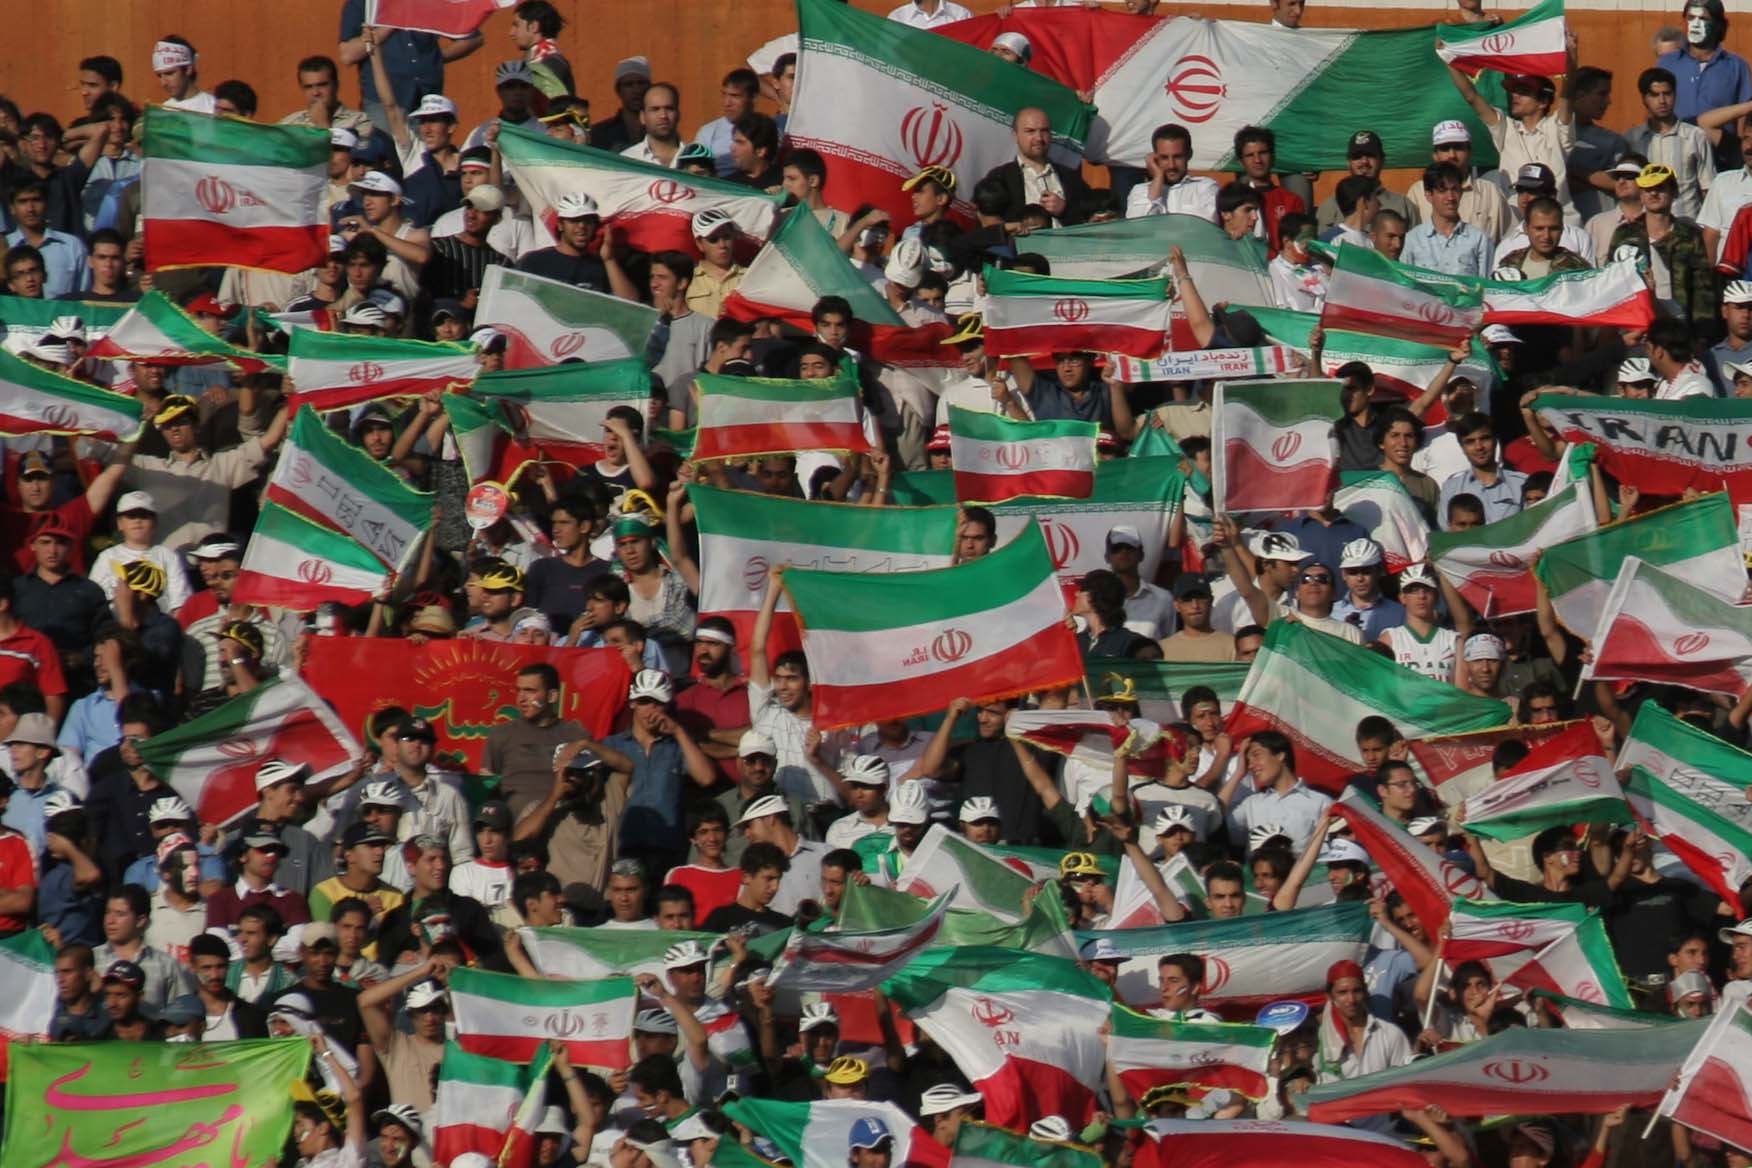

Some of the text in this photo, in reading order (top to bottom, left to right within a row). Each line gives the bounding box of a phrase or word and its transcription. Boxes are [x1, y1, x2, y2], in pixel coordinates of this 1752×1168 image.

[1162, 362, 1248, 377] IRAN IRAN
[1567, 411, 1738, 461] IRAN
